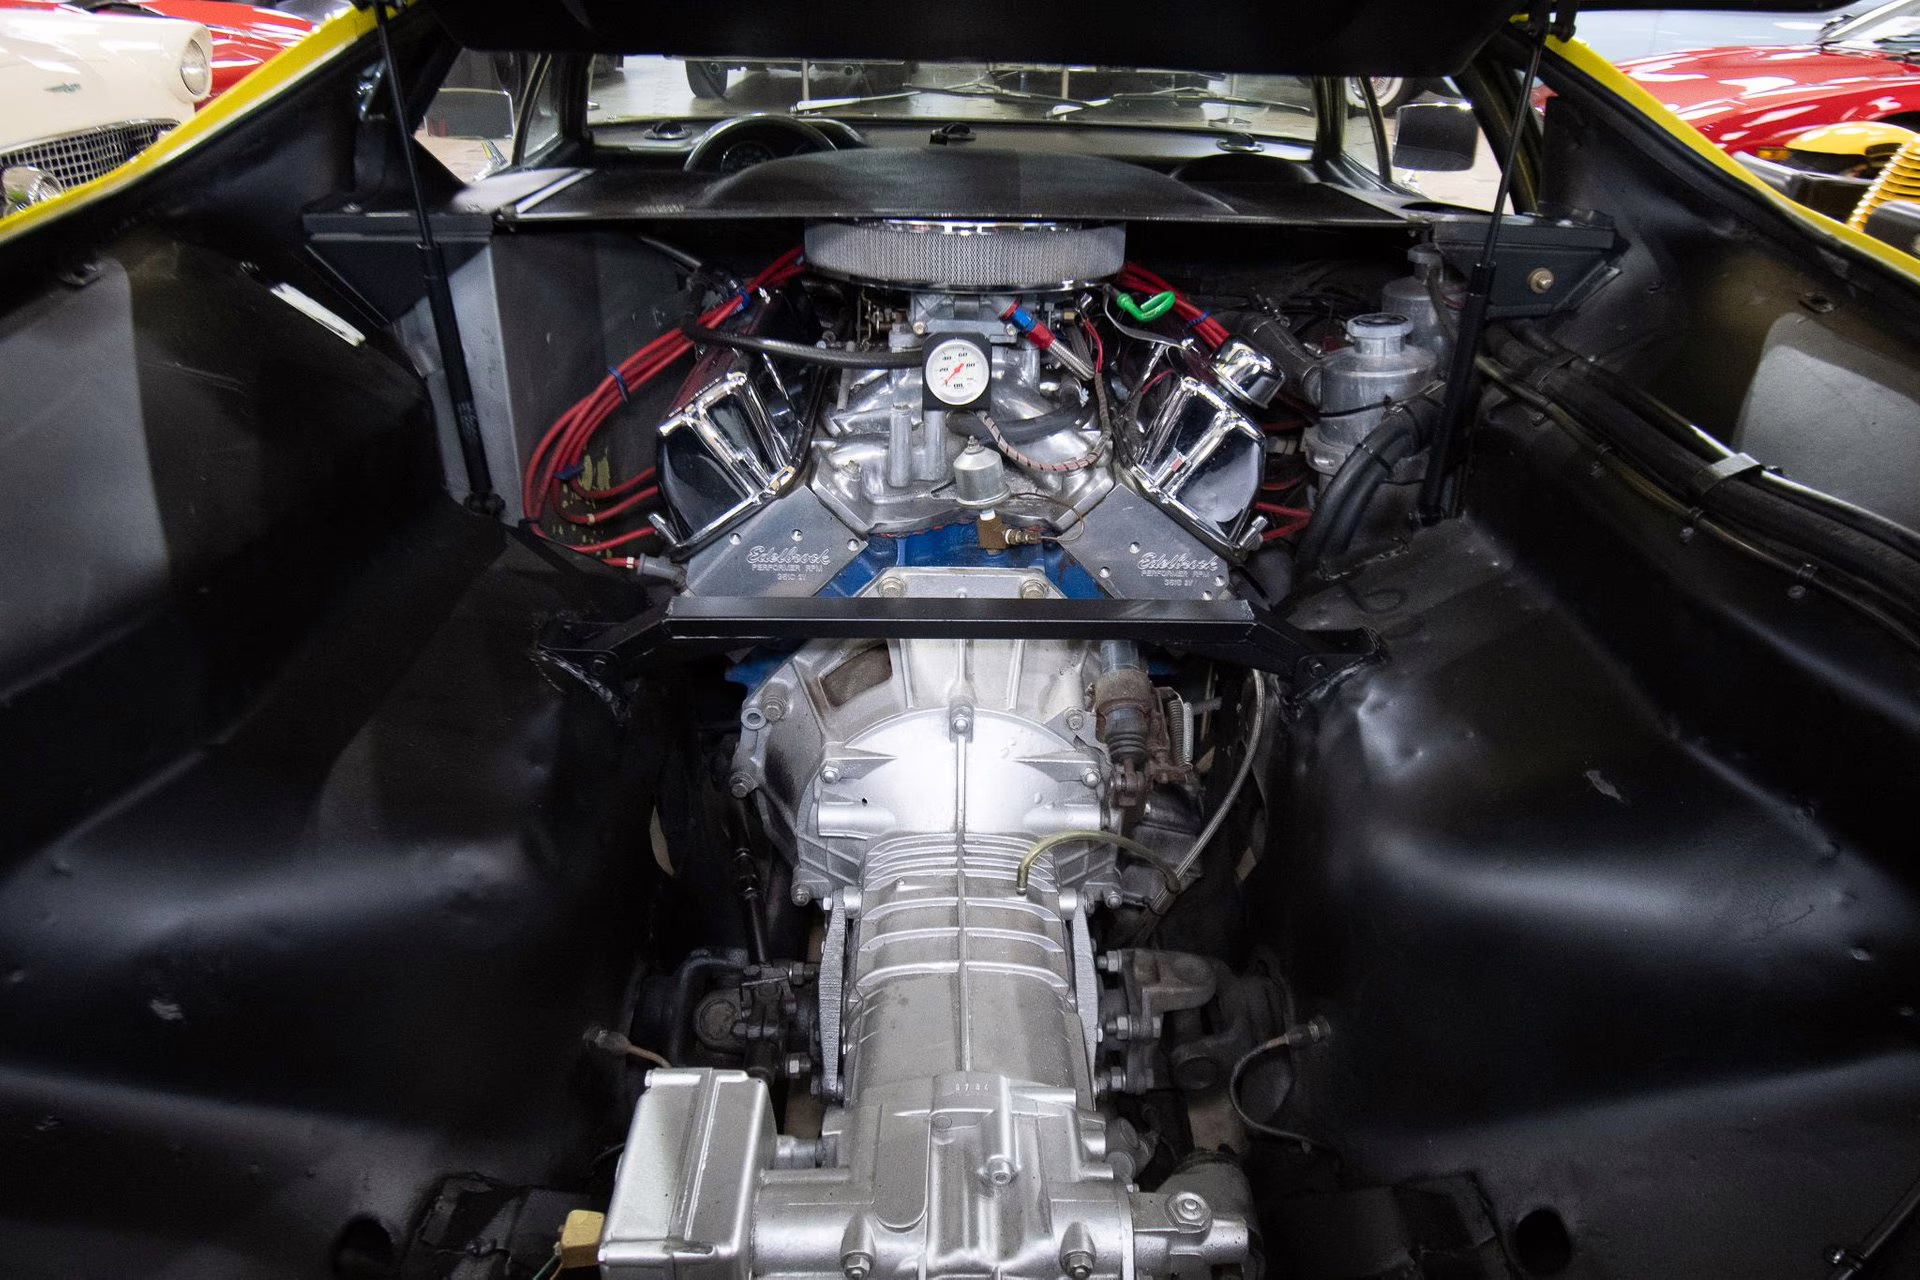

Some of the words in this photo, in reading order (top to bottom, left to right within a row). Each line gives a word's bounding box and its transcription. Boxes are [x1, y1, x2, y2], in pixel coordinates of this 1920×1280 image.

[746, 545, 831, 565] Edelbrock
[1138, 552, 1219, 571] Edelbrock
[752, 564, 801, 572] PERFORMER
[805, 564, 823, 573] RPM
[1141, 569, 1188, 577] PERFORMER
